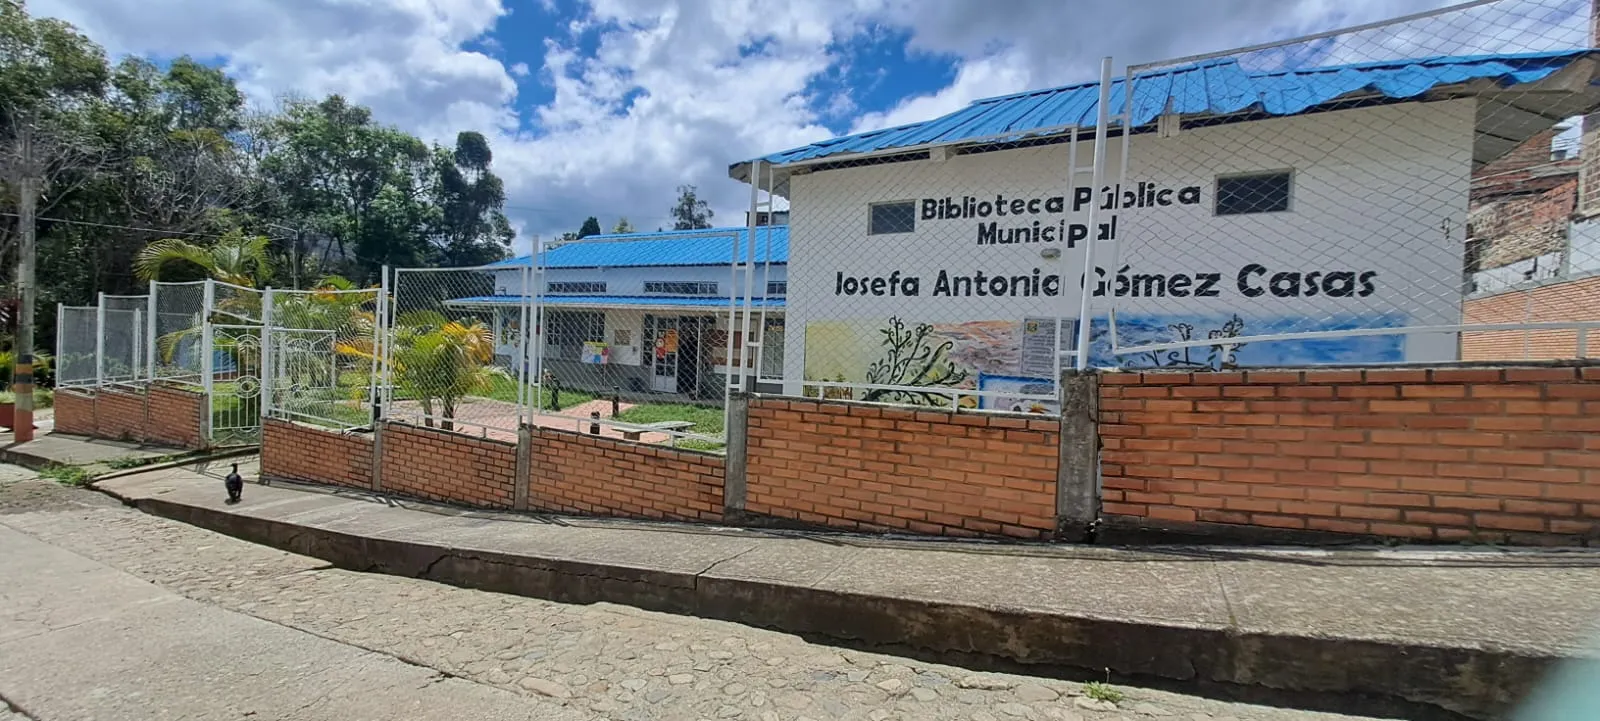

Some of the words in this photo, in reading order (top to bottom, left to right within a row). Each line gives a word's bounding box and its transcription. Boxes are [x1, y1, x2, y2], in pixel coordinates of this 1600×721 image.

[921, 194, 1064, 220] Biblioteca
[1073, 182, 1201, 212] Pública
[977, 215, 1117, 248] Municipal
[835, 270, 920, 297] Josefa
[1080, 264, 1221, 298] Gómez
[1237, 263, 1378, 298] Casas
